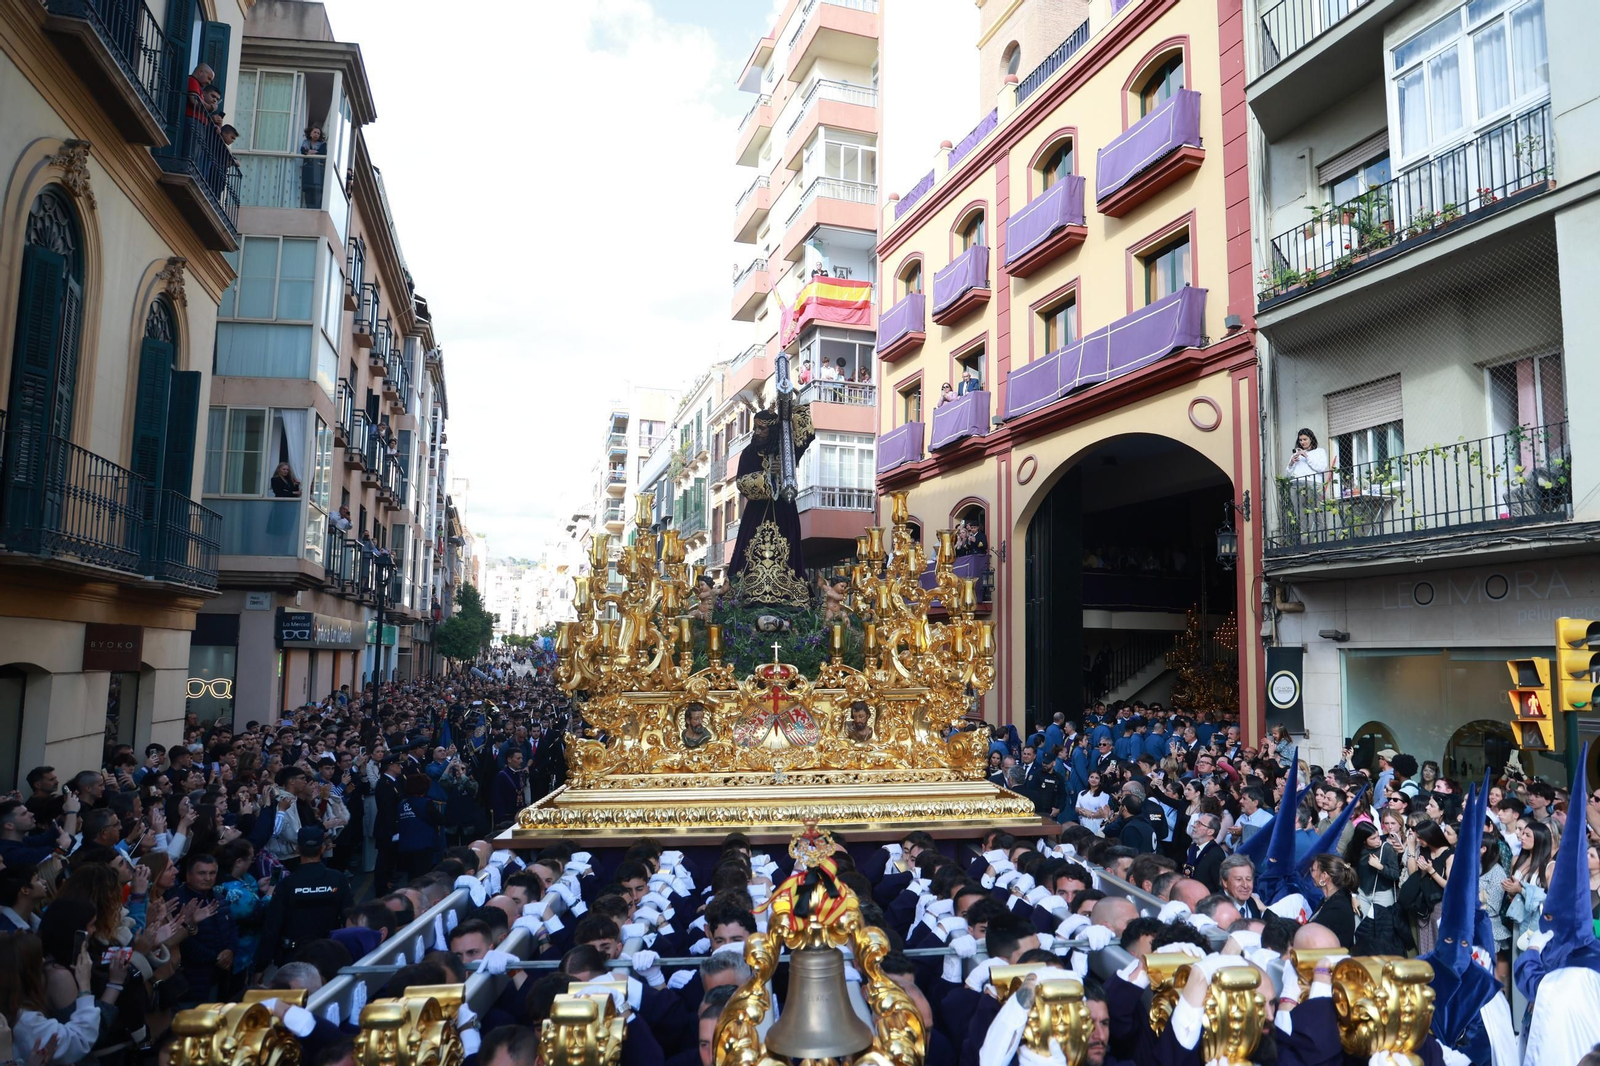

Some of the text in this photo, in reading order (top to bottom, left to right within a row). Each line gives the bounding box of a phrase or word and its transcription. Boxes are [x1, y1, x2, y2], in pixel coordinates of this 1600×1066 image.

[1381, 567, 1572, 609] LEO MORA
[90, 641, 133, 649] BYOKO
[295, 886, 333, 894] POLICIA
